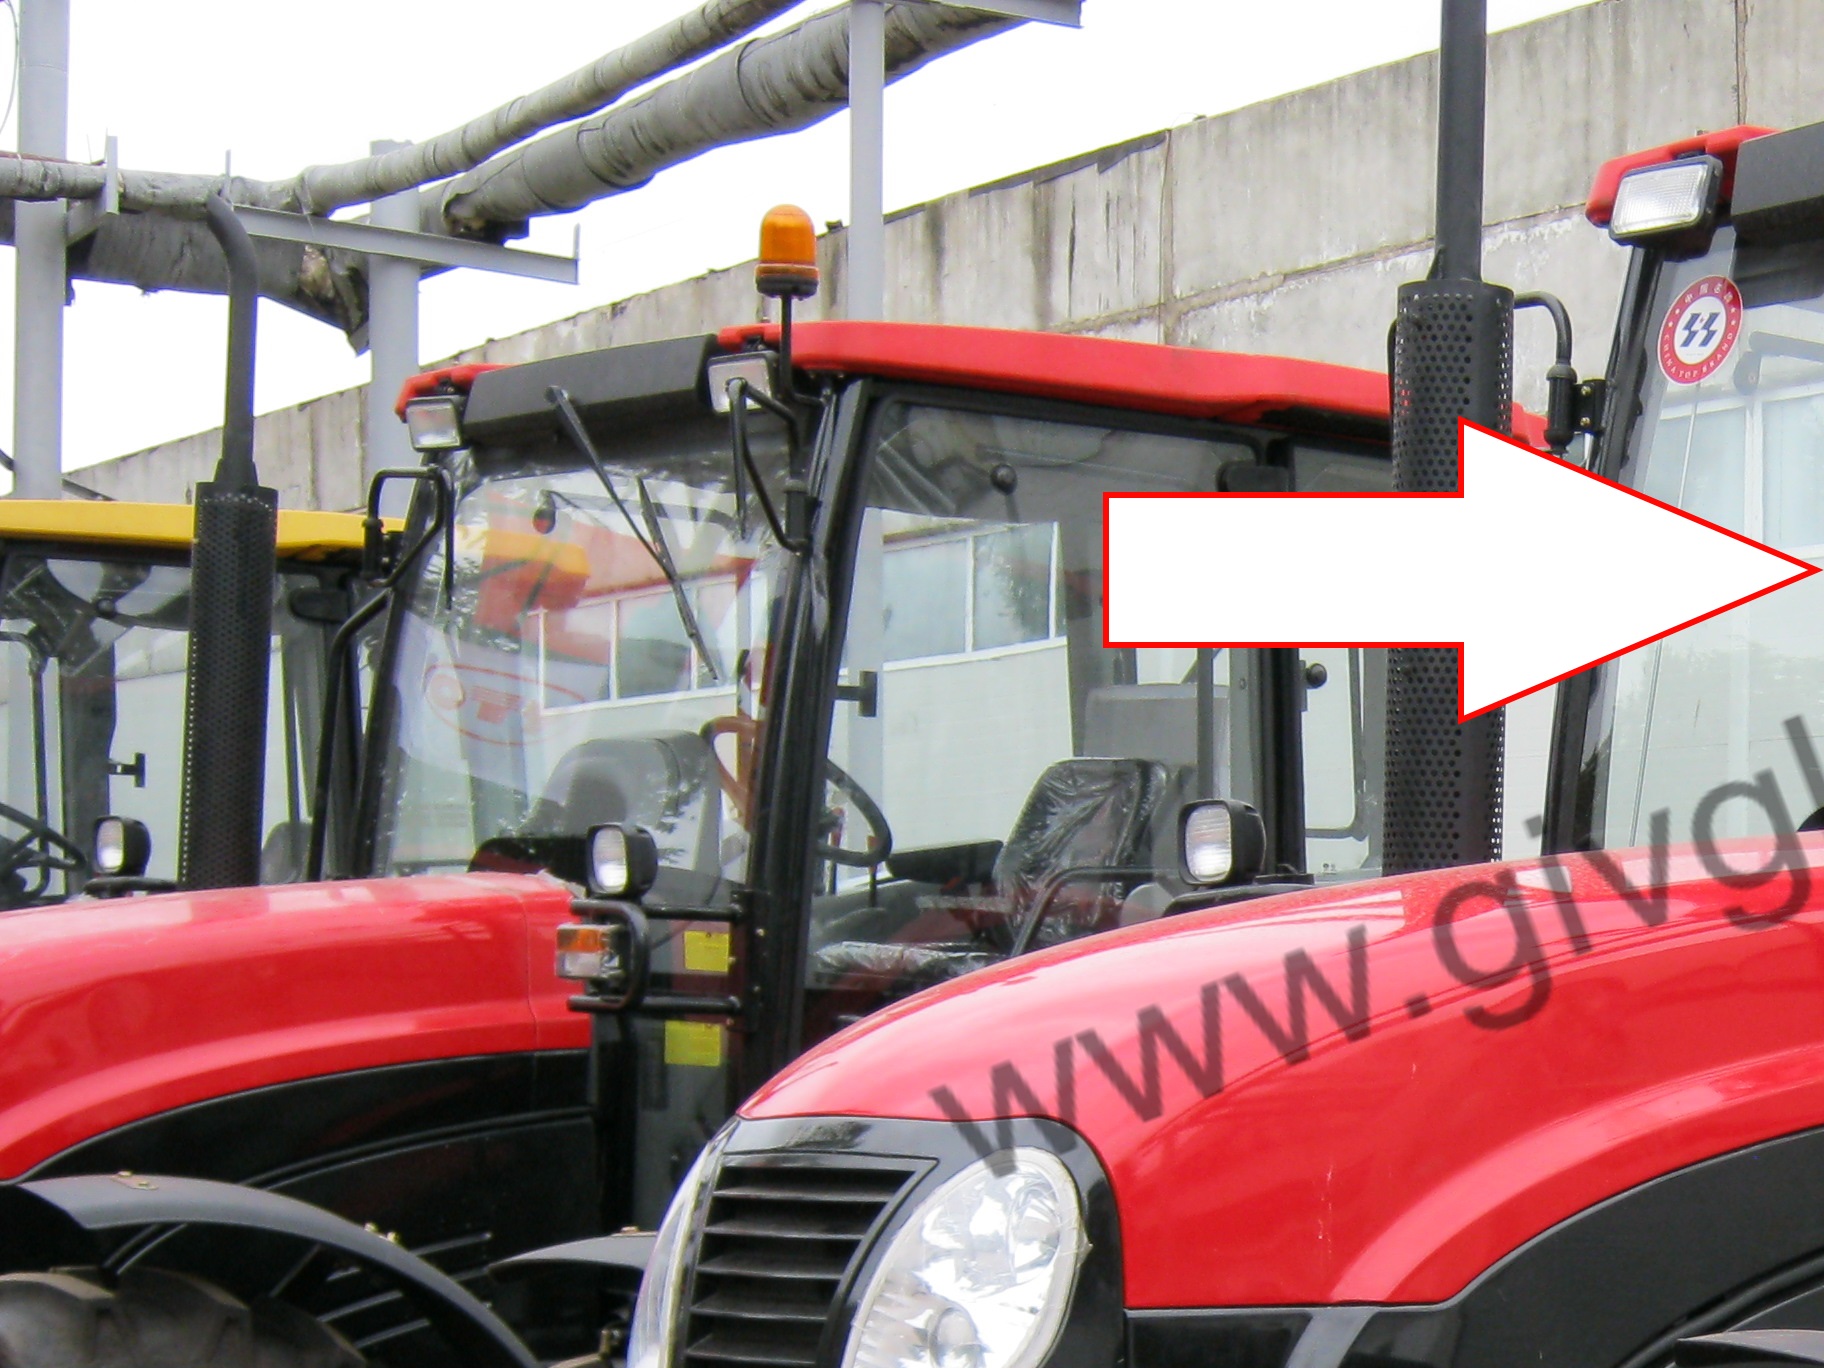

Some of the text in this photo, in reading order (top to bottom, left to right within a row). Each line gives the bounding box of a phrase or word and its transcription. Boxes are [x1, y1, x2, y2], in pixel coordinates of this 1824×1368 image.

[1663, 333, 1733, 379] CHINA TOP BRAND
